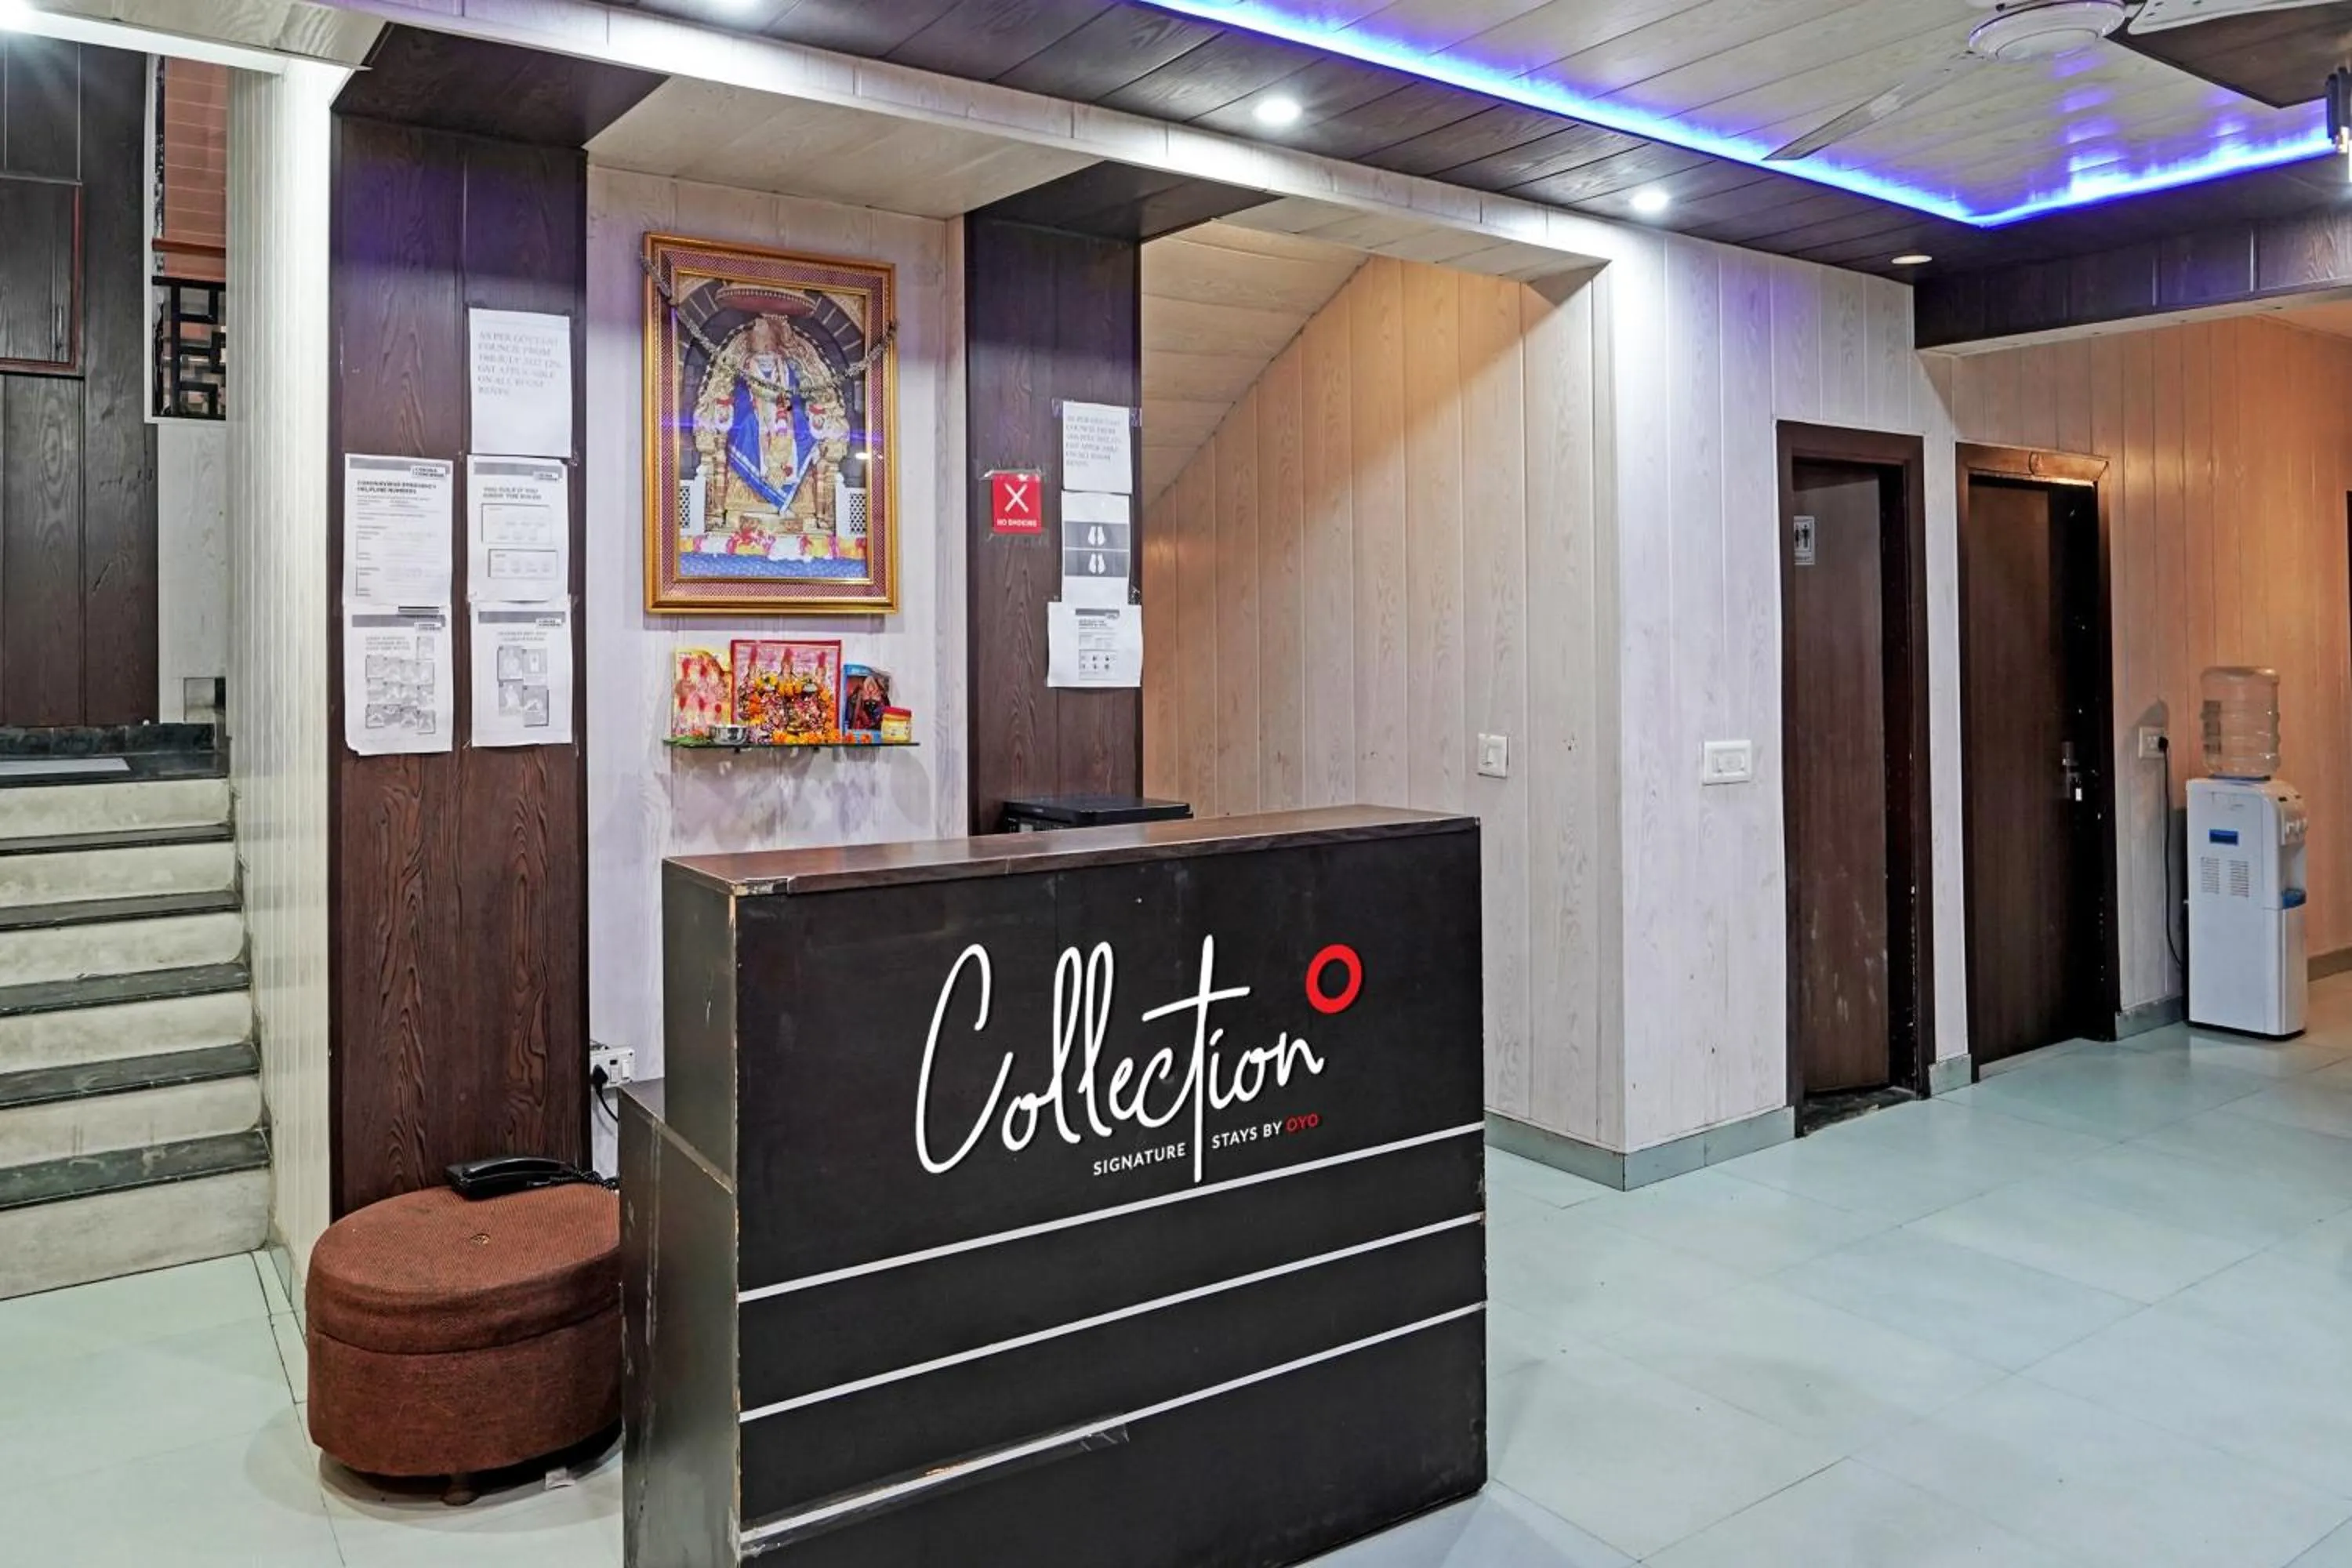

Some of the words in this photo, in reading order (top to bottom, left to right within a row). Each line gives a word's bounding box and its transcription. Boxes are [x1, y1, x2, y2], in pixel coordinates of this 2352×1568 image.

[996, 517, 1007, 526] NO
[915, 935, 1325, 1183] Collection
[1093, 1142, 1186, 1176] SIGNATURE
[1211, 1127, 1258, 1149] STAYS
[1262, 1120, 1283, 1138] BY
[1285, 1112, 1319, 1133] OYO
